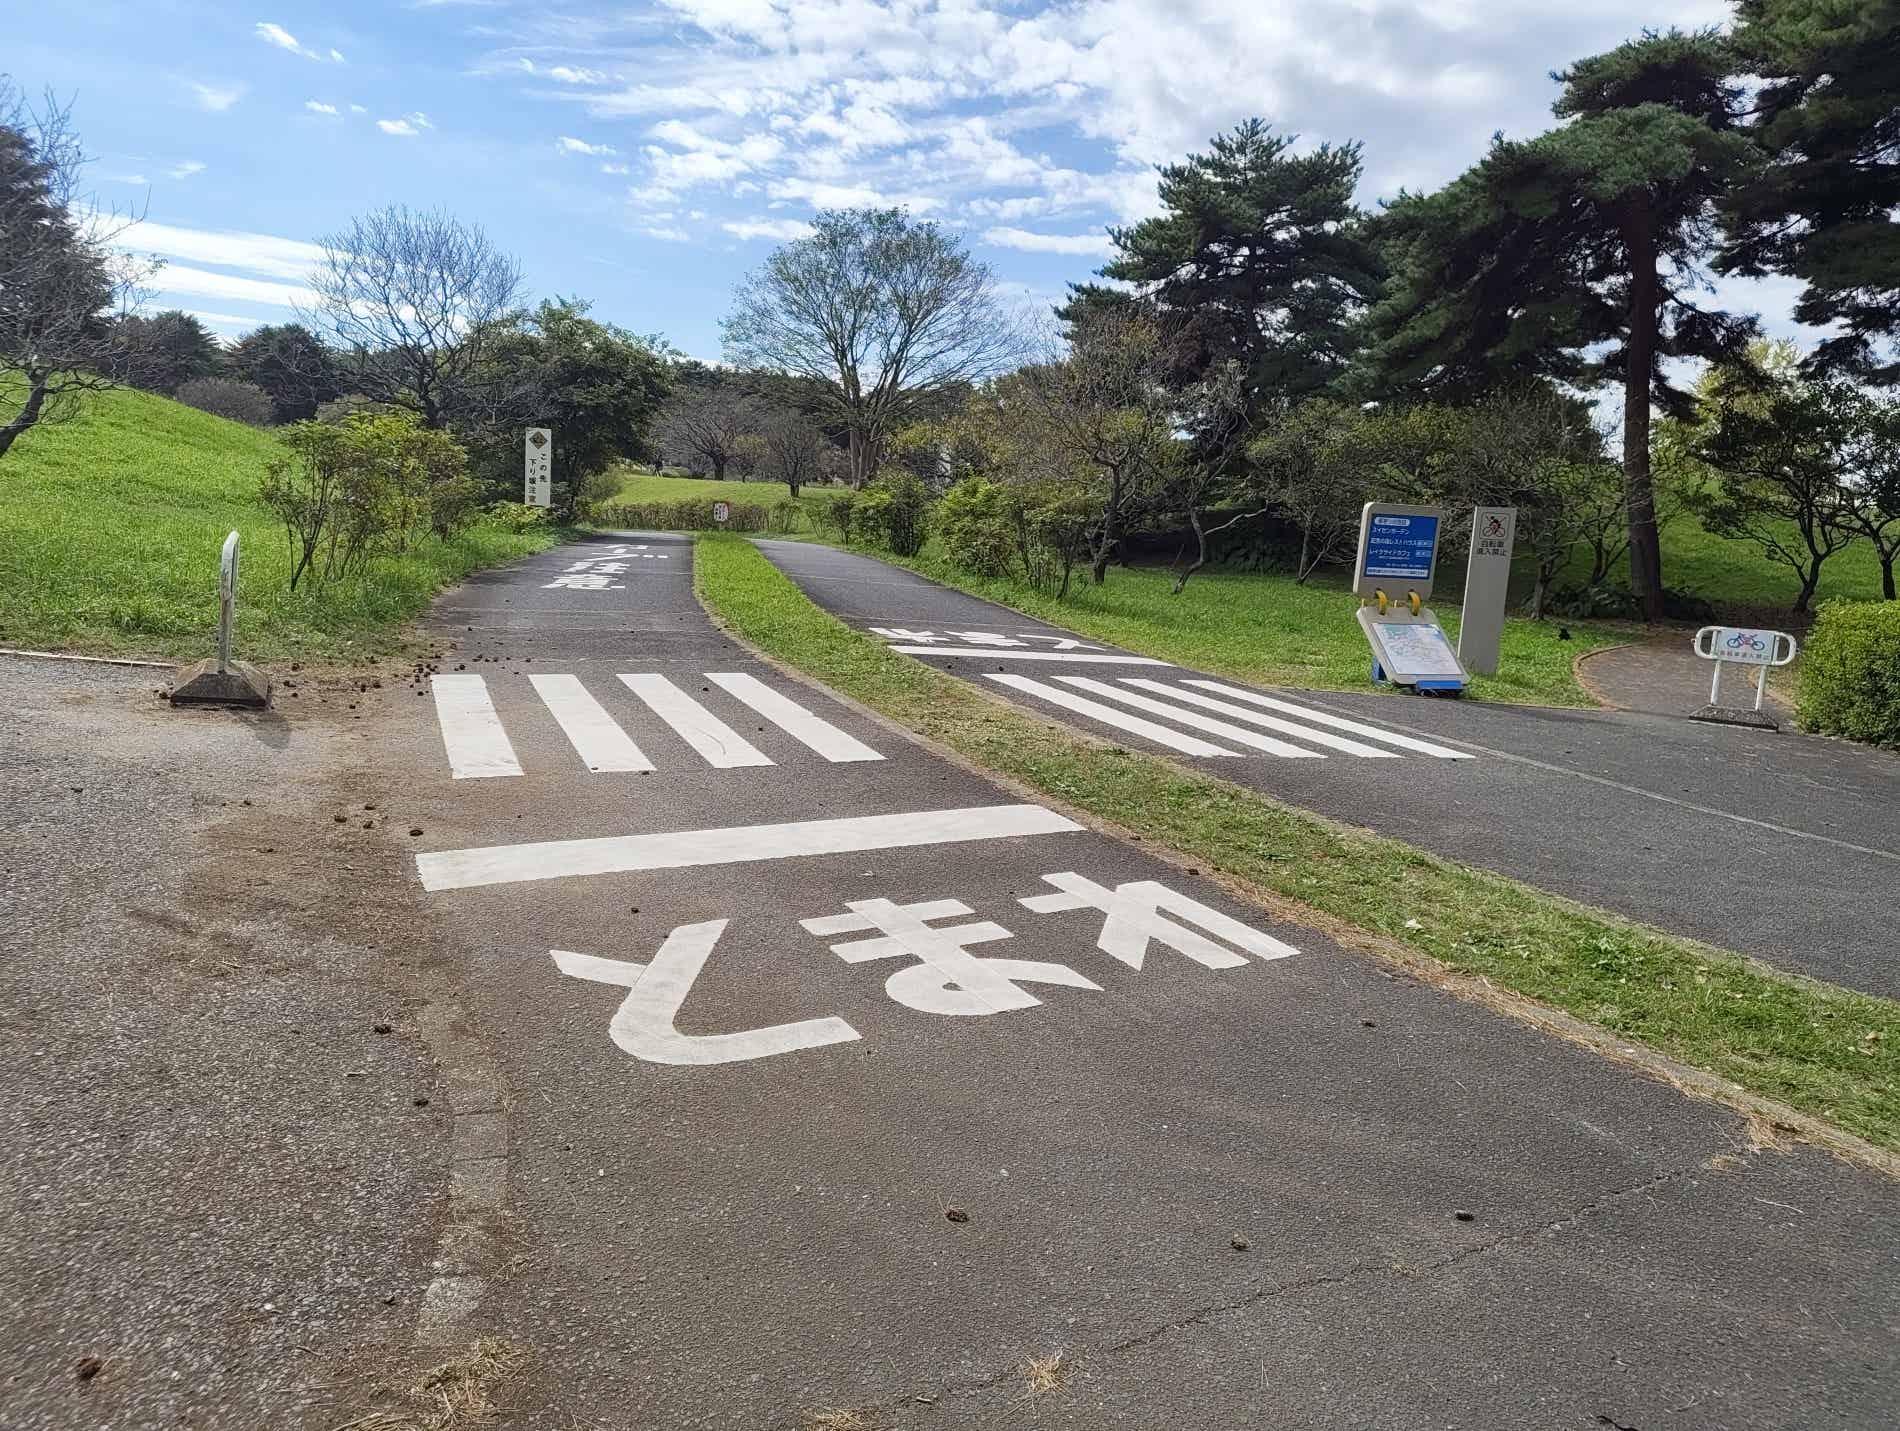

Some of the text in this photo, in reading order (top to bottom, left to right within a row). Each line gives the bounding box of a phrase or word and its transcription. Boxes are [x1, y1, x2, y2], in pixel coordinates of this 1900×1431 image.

[539, 453, 548, 483] この先
[549, 871, 1302, 1066] とまれ
